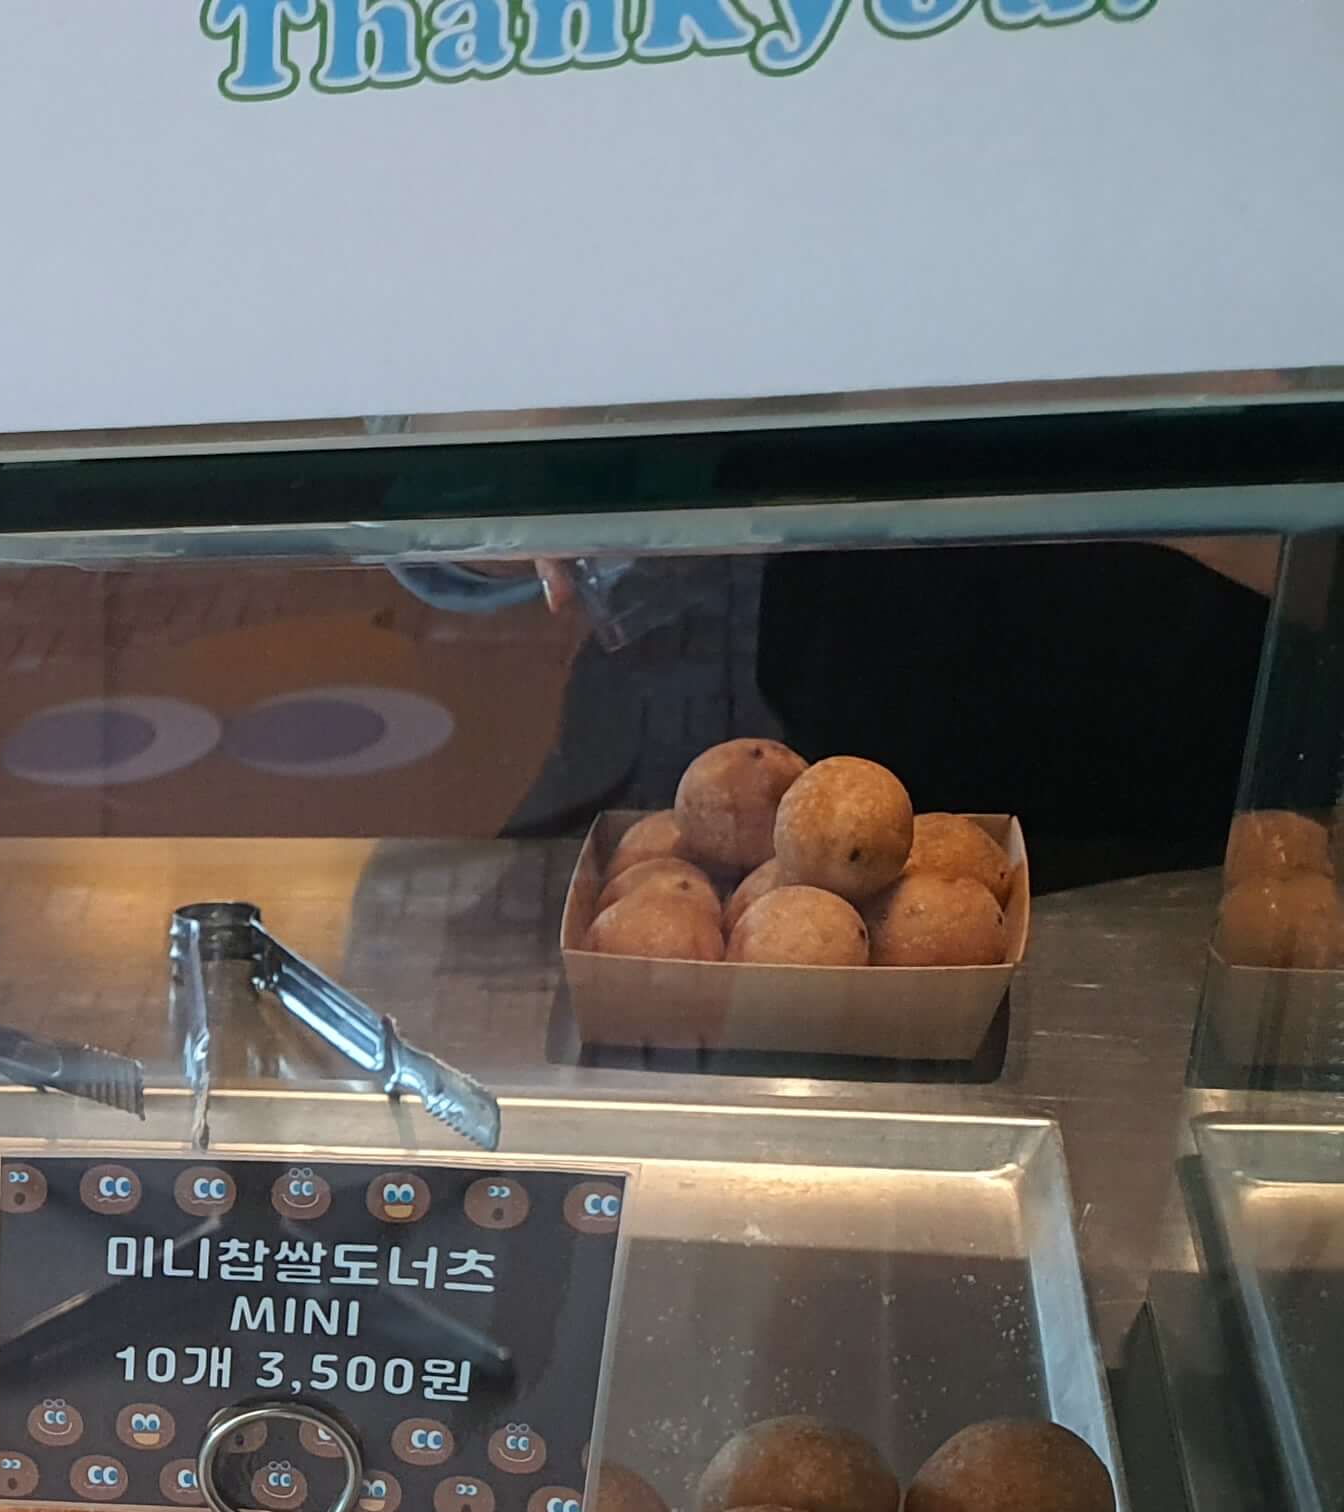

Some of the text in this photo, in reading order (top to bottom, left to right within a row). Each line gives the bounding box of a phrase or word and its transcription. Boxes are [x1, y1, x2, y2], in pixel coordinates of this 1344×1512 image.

[106, 1236, 496, 1294] 미니찹쌀도너츠
[229, 1296, 360, 1337] MINI
[115, 1346, 472, 1402] 10개 3,500원
